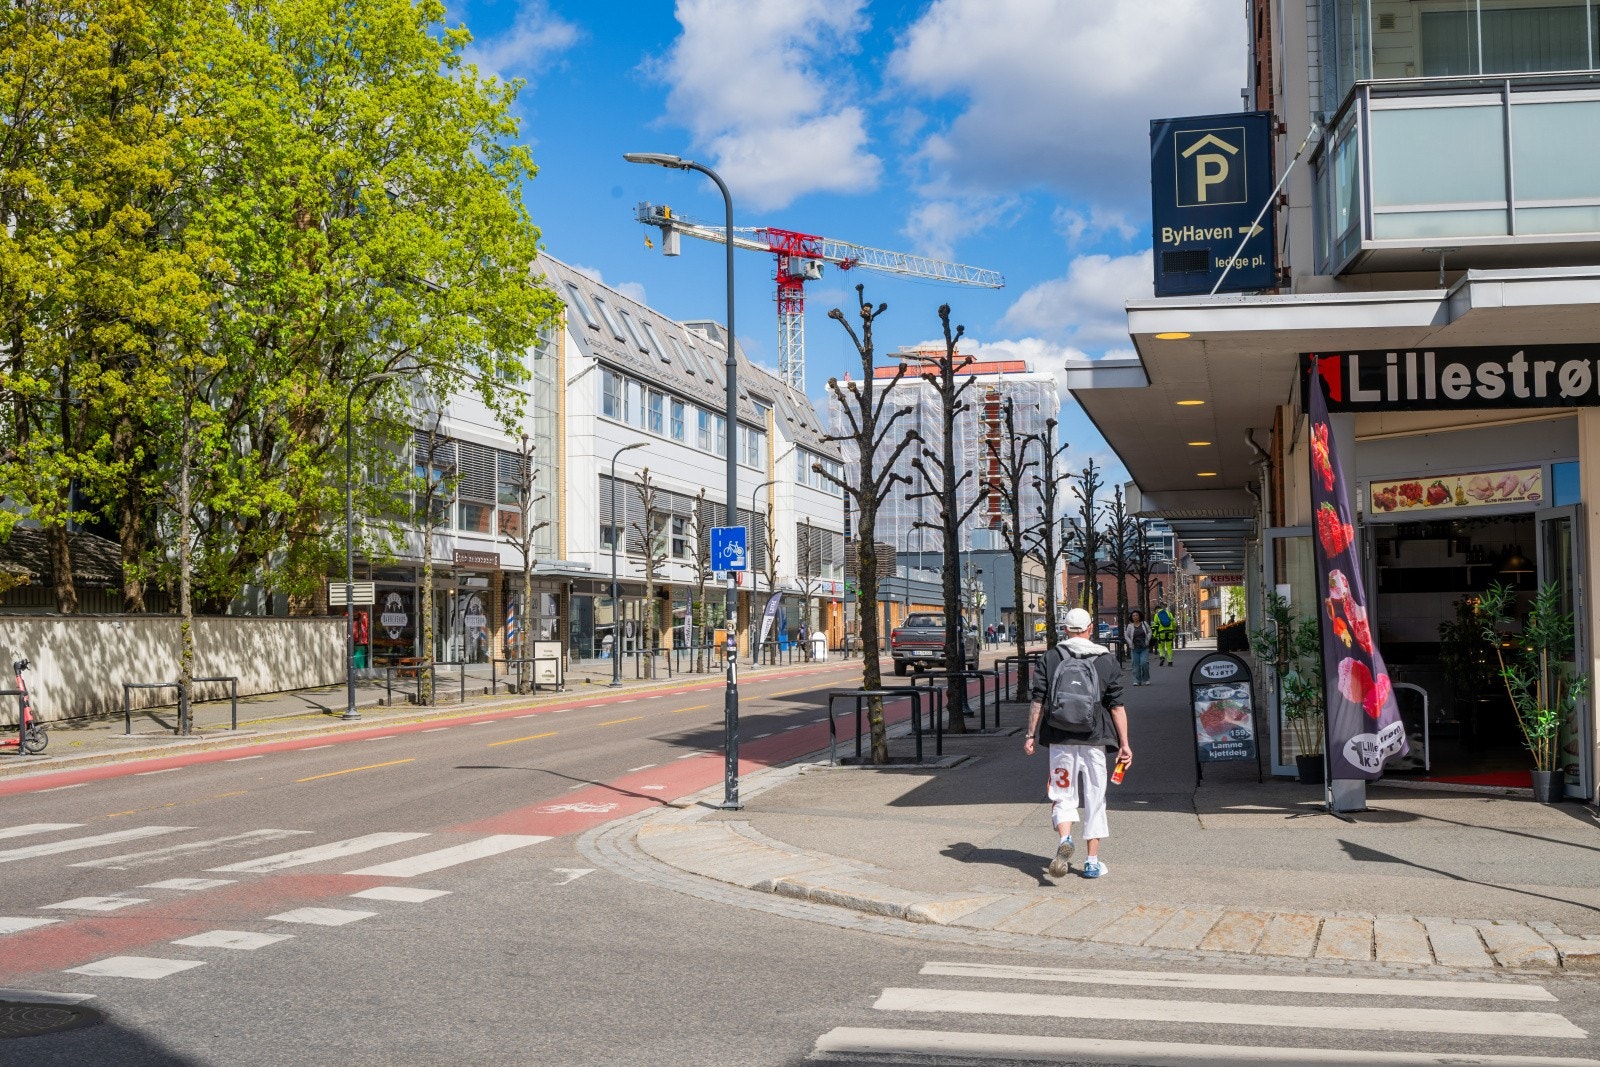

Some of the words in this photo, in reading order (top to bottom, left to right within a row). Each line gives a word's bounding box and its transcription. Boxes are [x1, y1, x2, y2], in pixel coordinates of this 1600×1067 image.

[1196, 153, 1229, 202] P
[1161, 225, 1233, 246] ByHaven
[1252, 255, 1266, 268] pl.
[1349, 351, 1600, 402] Lillestrø
[1209, 749, 1247, 758] kjøttdeig
[1054, 767, 1070, 788] 3
